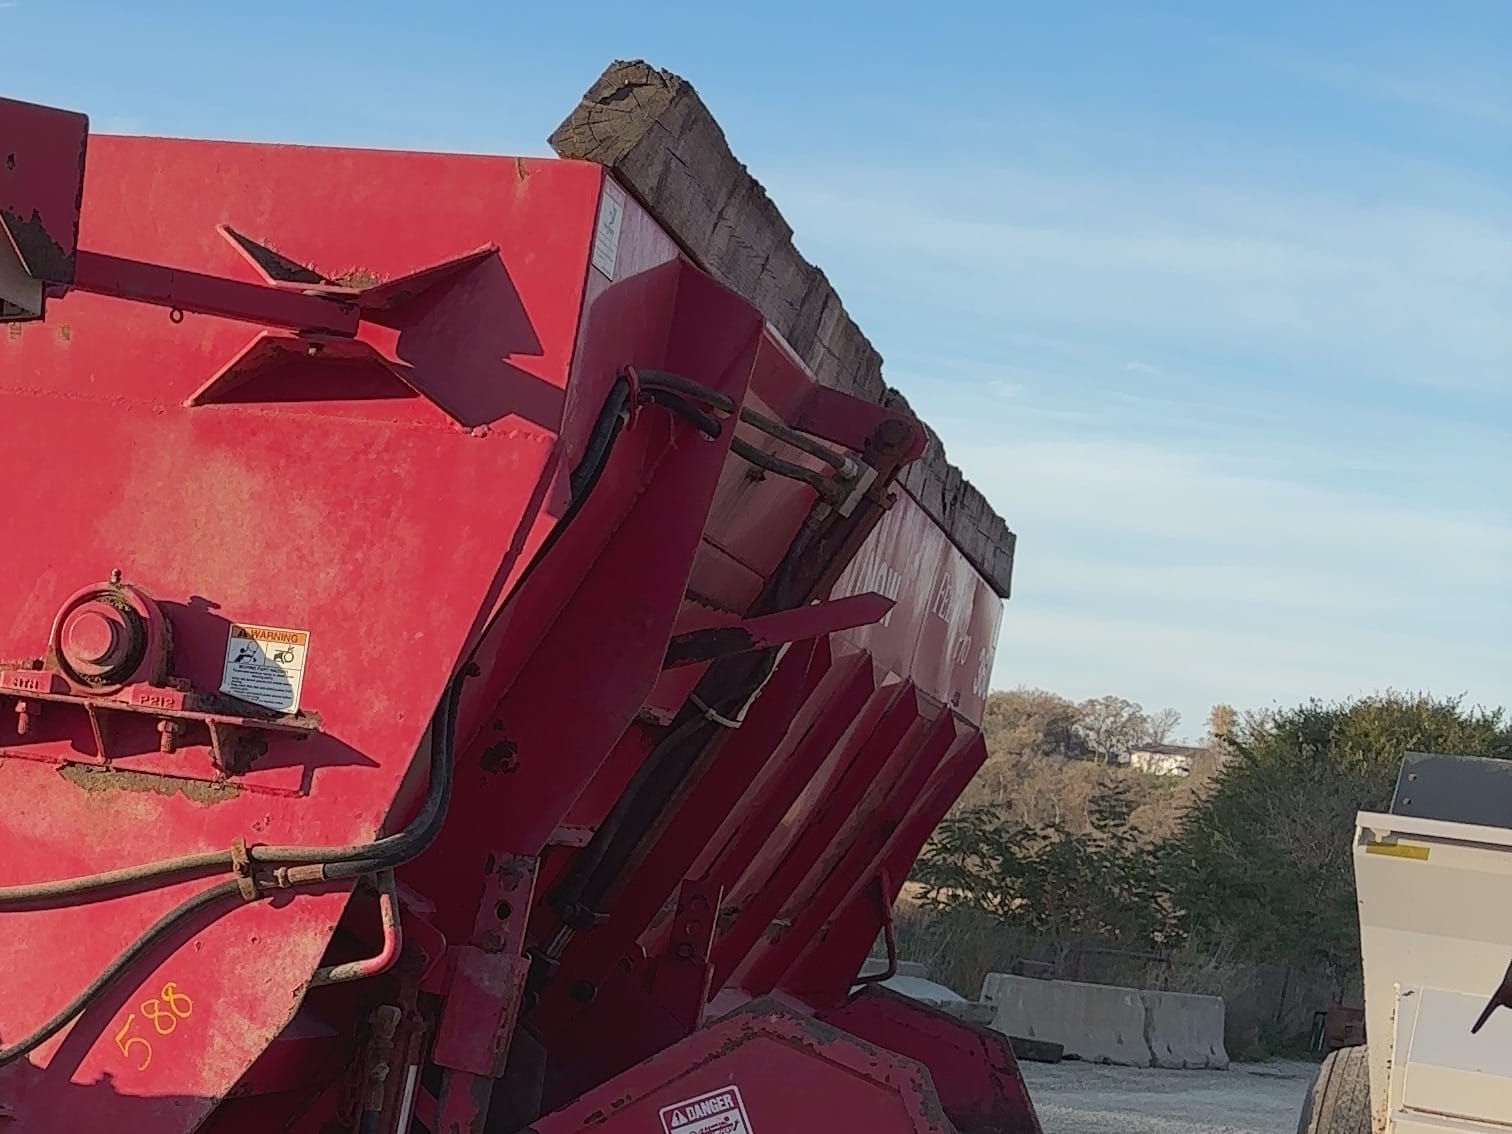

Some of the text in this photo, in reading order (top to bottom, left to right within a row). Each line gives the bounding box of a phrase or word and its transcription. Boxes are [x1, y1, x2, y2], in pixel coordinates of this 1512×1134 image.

[251, 630, 298, 643] WARNING
[115, 982, 193, 1072] 588
[686, 1093, 735, 1121] DANGER
